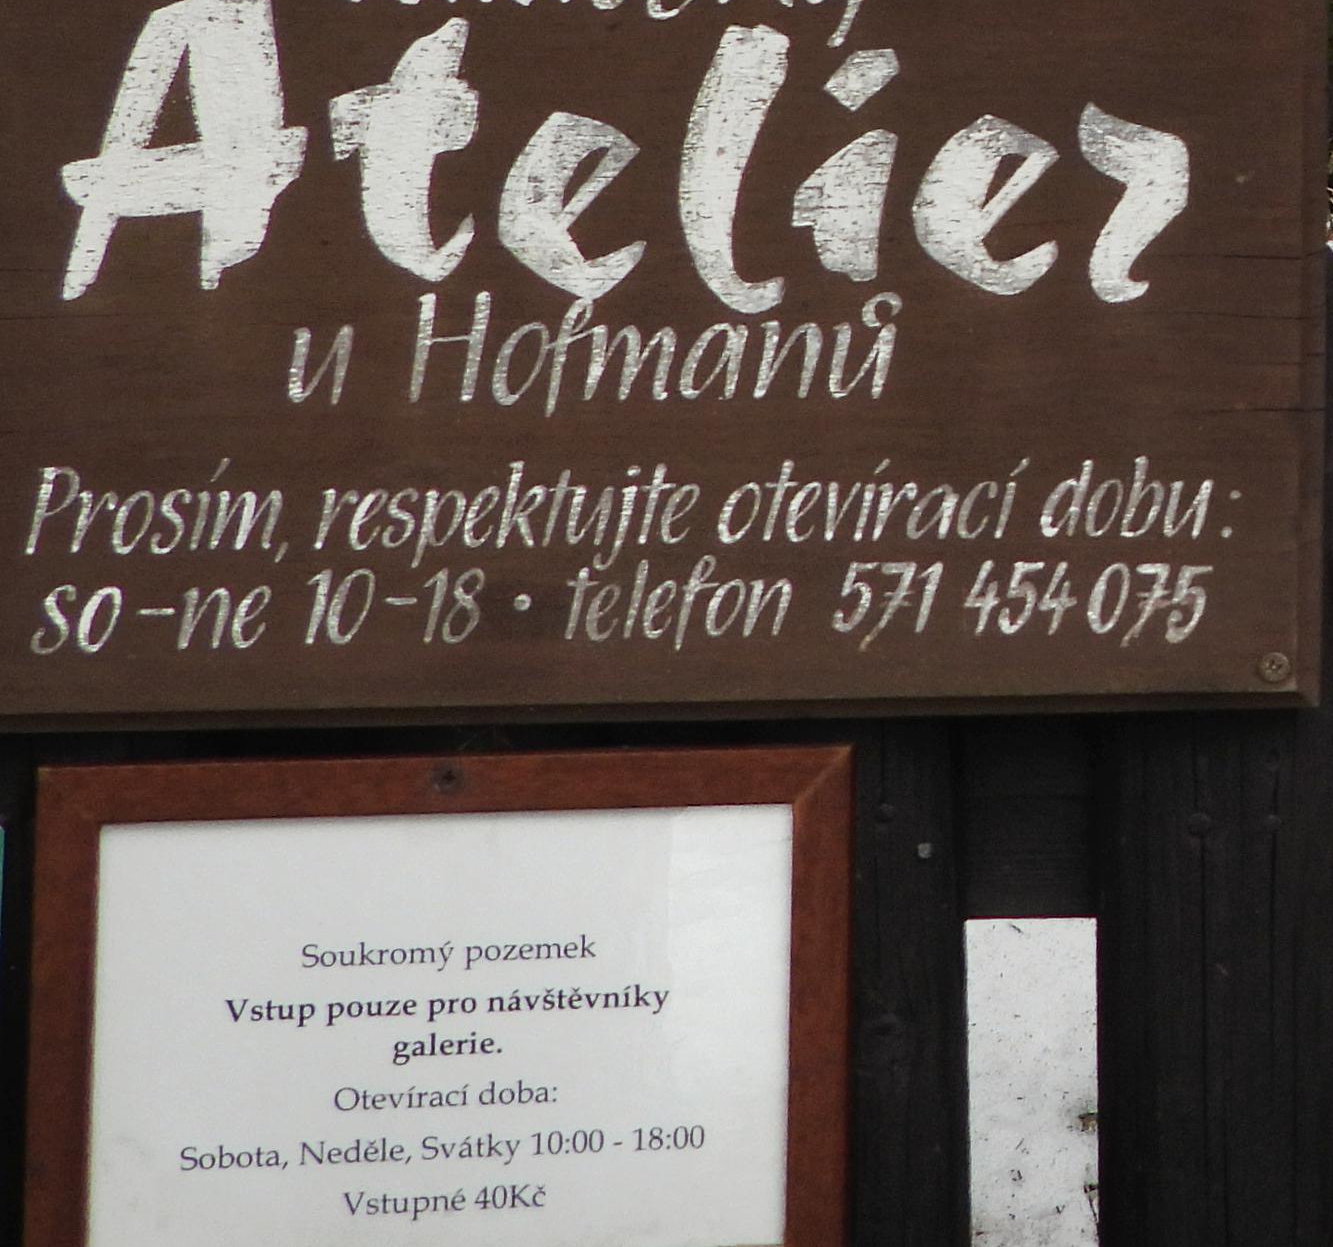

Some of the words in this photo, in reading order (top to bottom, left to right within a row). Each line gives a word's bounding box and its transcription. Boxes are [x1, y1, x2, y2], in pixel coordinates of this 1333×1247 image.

[288, 324, 354, 404] u
[409, 291, 902, 418] Hofmanů
[25, 457, 288, 562] Prosím,
[313, 460, 700, 569] respektujte
[717, 457, 1030, 544] otevírací
[1039, 456, 1242, 538] dobu:
[564, 555, 794, 651] telefon
[832, 561, 943, 651] 571
[964, 560, 1076, 635] 454
[1086, 562, 1213, 648] 075
[302, 941, 454, 972] Soukromý
[465, 934, 597, 970] pozemek
[225, 998, 316, 1027] Vstup
[326, 998, 418, 1027] pouze
[428, 996, 477, 1022] pro
[487, 984, 670, 1015] návštěvníky
[392, 1031, 503, 1066] galerie.
[334, 1084, 469, 1112] Otevírací
[478, 1080, 558, 1106] doba:
[180, 1145, 288, 1171] Sobota,
[300, 1137, 412, 1166] Neděle,
[421, 1133, 521, 1166] Svátky
[531, 1128, 604, 1156] 10:00
[632, 1124, 706, 1152] 18:00
[343, 1190, 466, 1221] Vstupné
[474, 1184, 547, 1210] 40Kč
